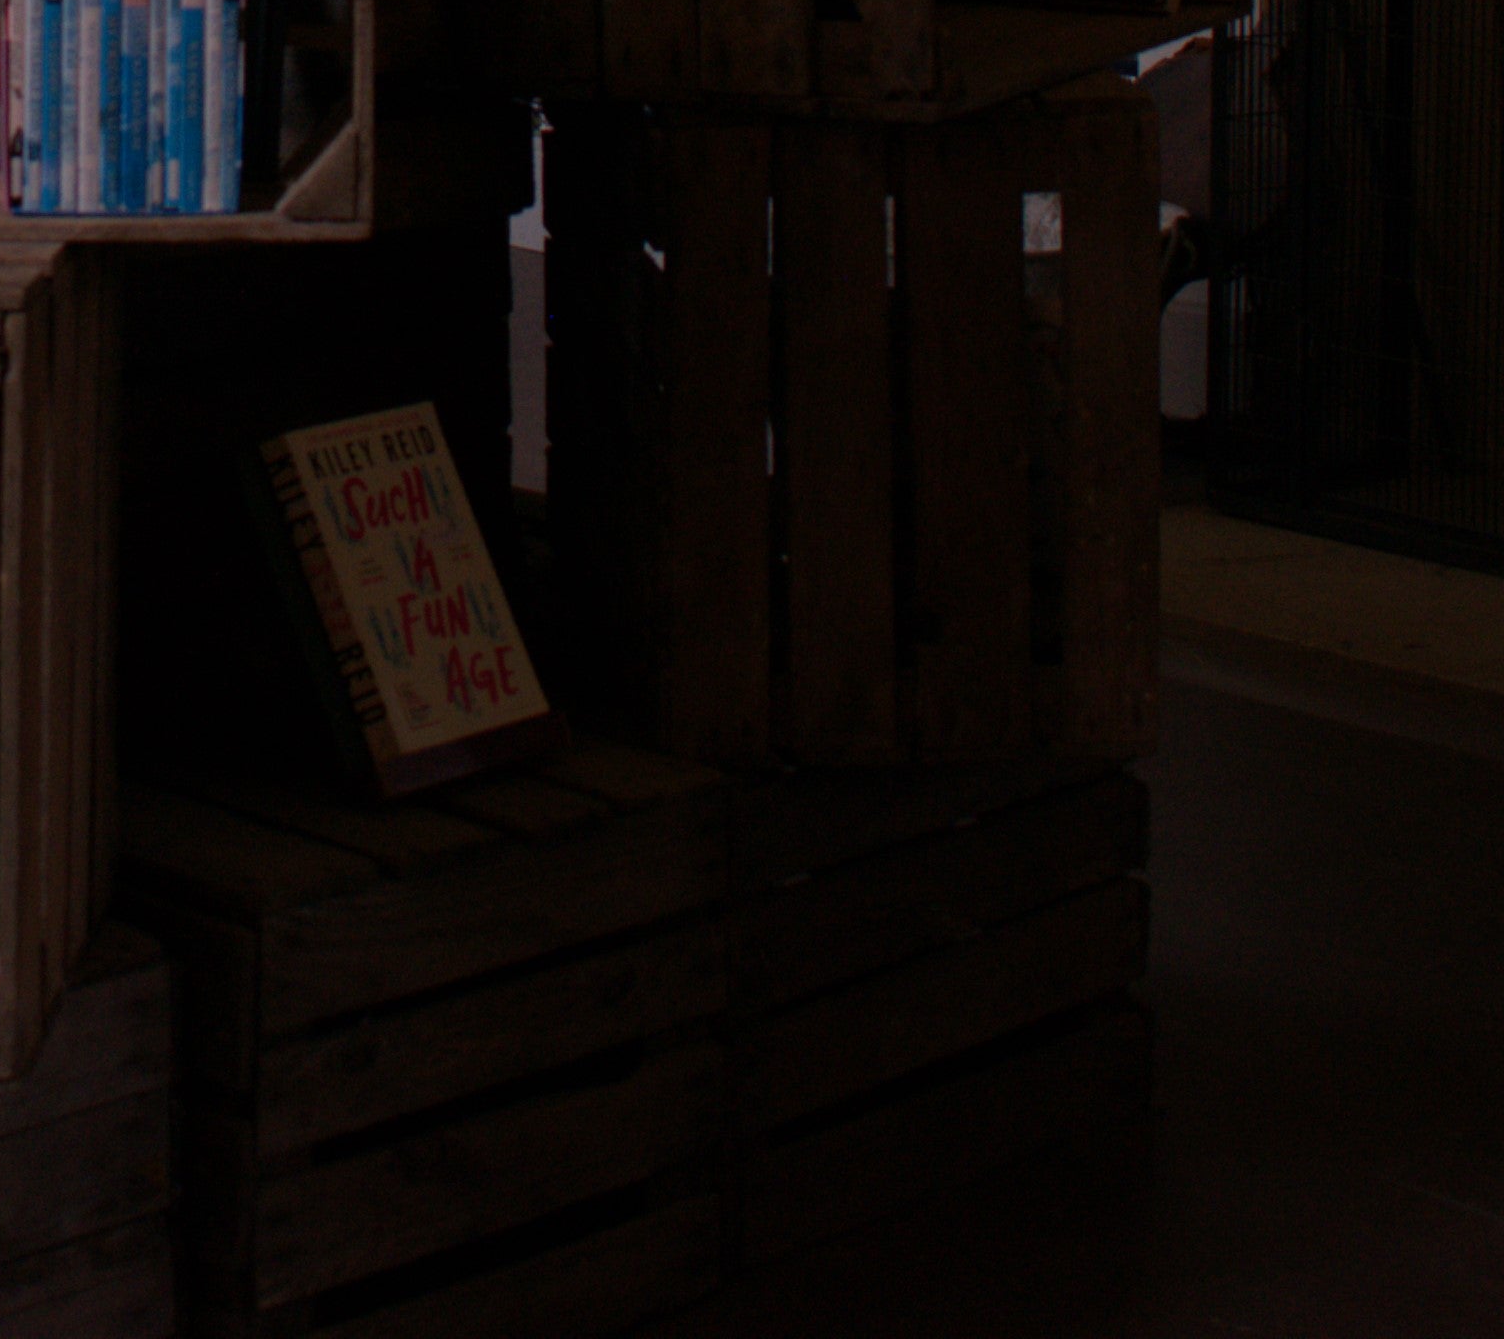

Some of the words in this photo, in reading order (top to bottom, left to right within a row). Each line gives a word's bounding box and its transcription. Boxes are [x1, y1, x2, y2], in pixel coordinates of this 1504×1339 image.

[308, 440, 372, 480] KILEY
[383, 424, 438, 463] REID
[341, 464, 430, 541] SUCH
[413, 536, 442, 592] A
[397, 585, 472, 657] FUN
[445, 645, 520, 713] AGE
